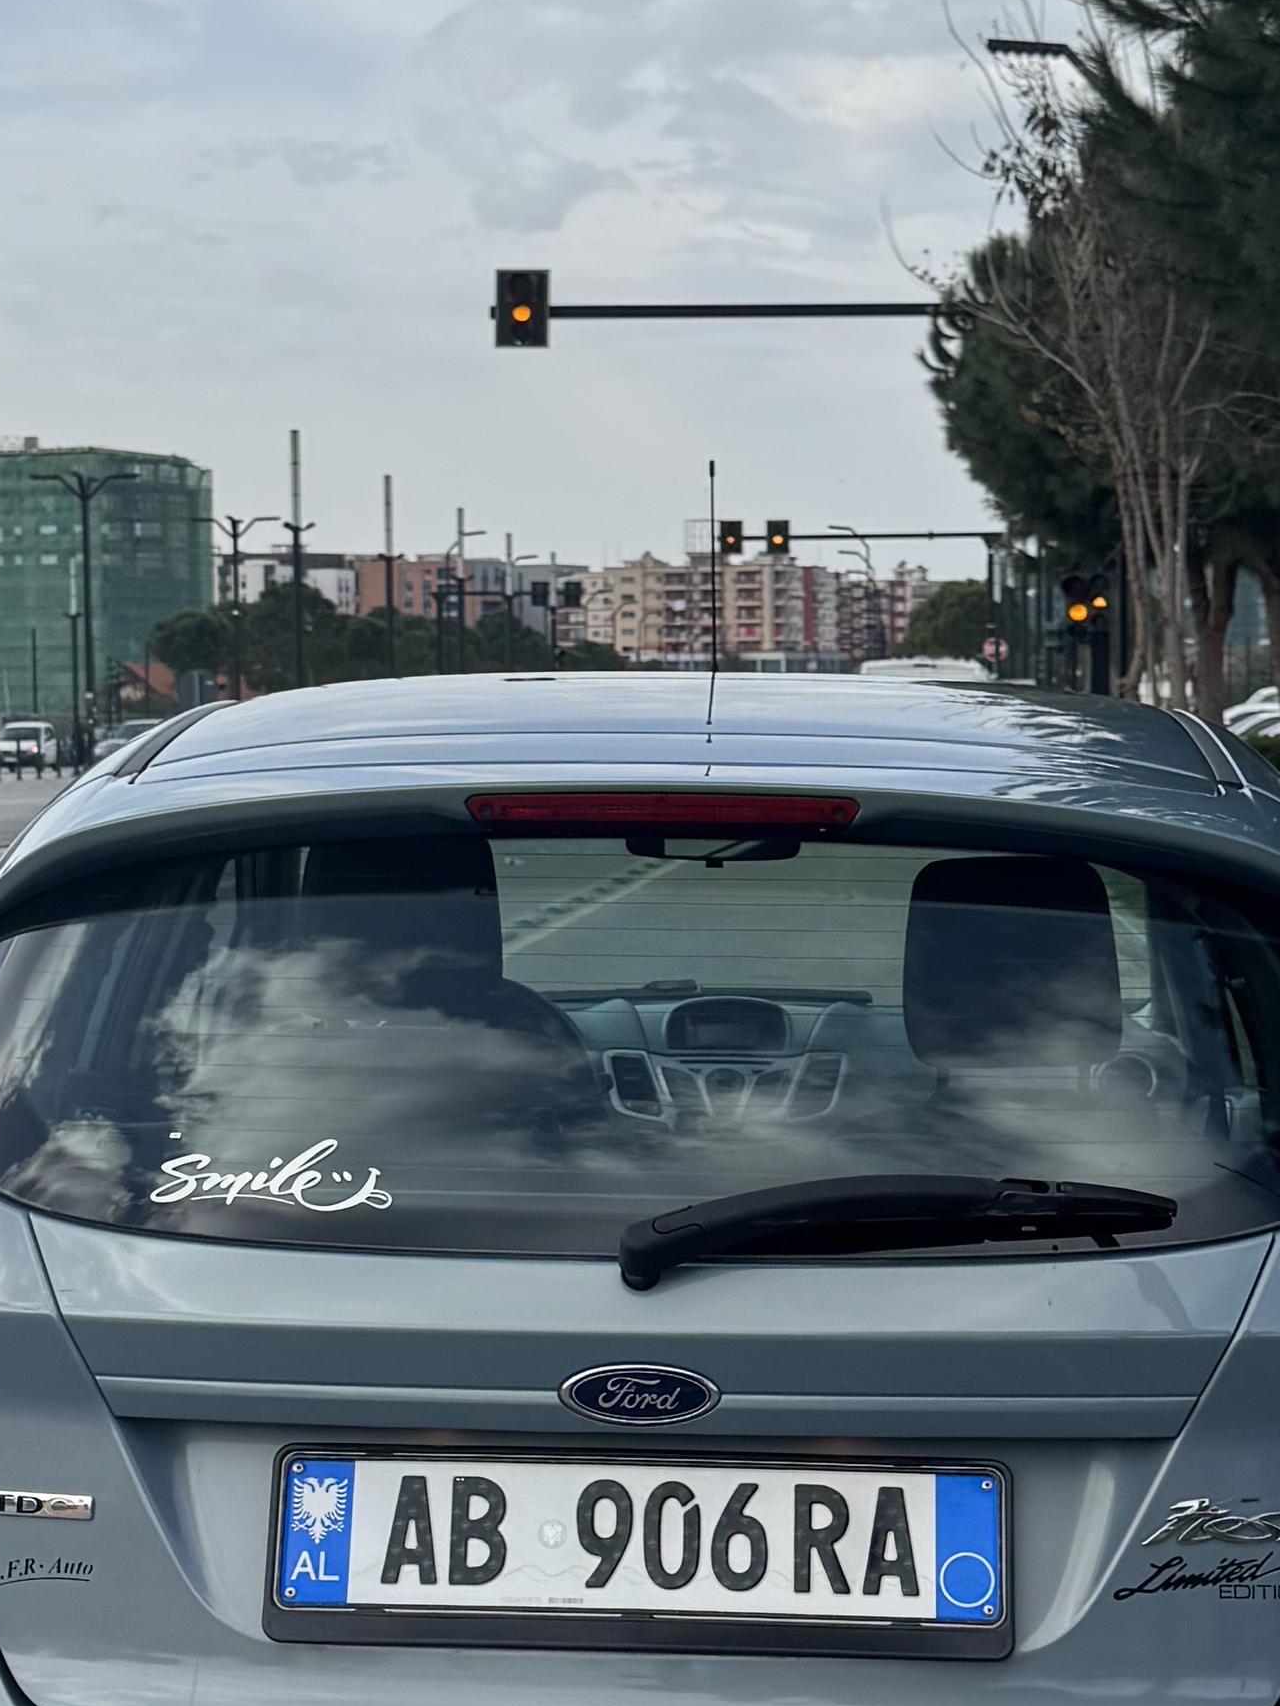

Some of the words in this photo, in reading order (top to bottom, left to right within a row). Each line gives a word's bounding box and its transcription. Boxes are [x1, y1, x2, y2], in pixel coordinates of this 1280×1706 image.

[150, 1139, 392, 1212] Smile
[598, 1376, 681, 1410] Ford
[380, 1475, 507, 1585] AB
[48, 1557, 94, 1575] Auto
[290, 1550, 340, 1581] AL
